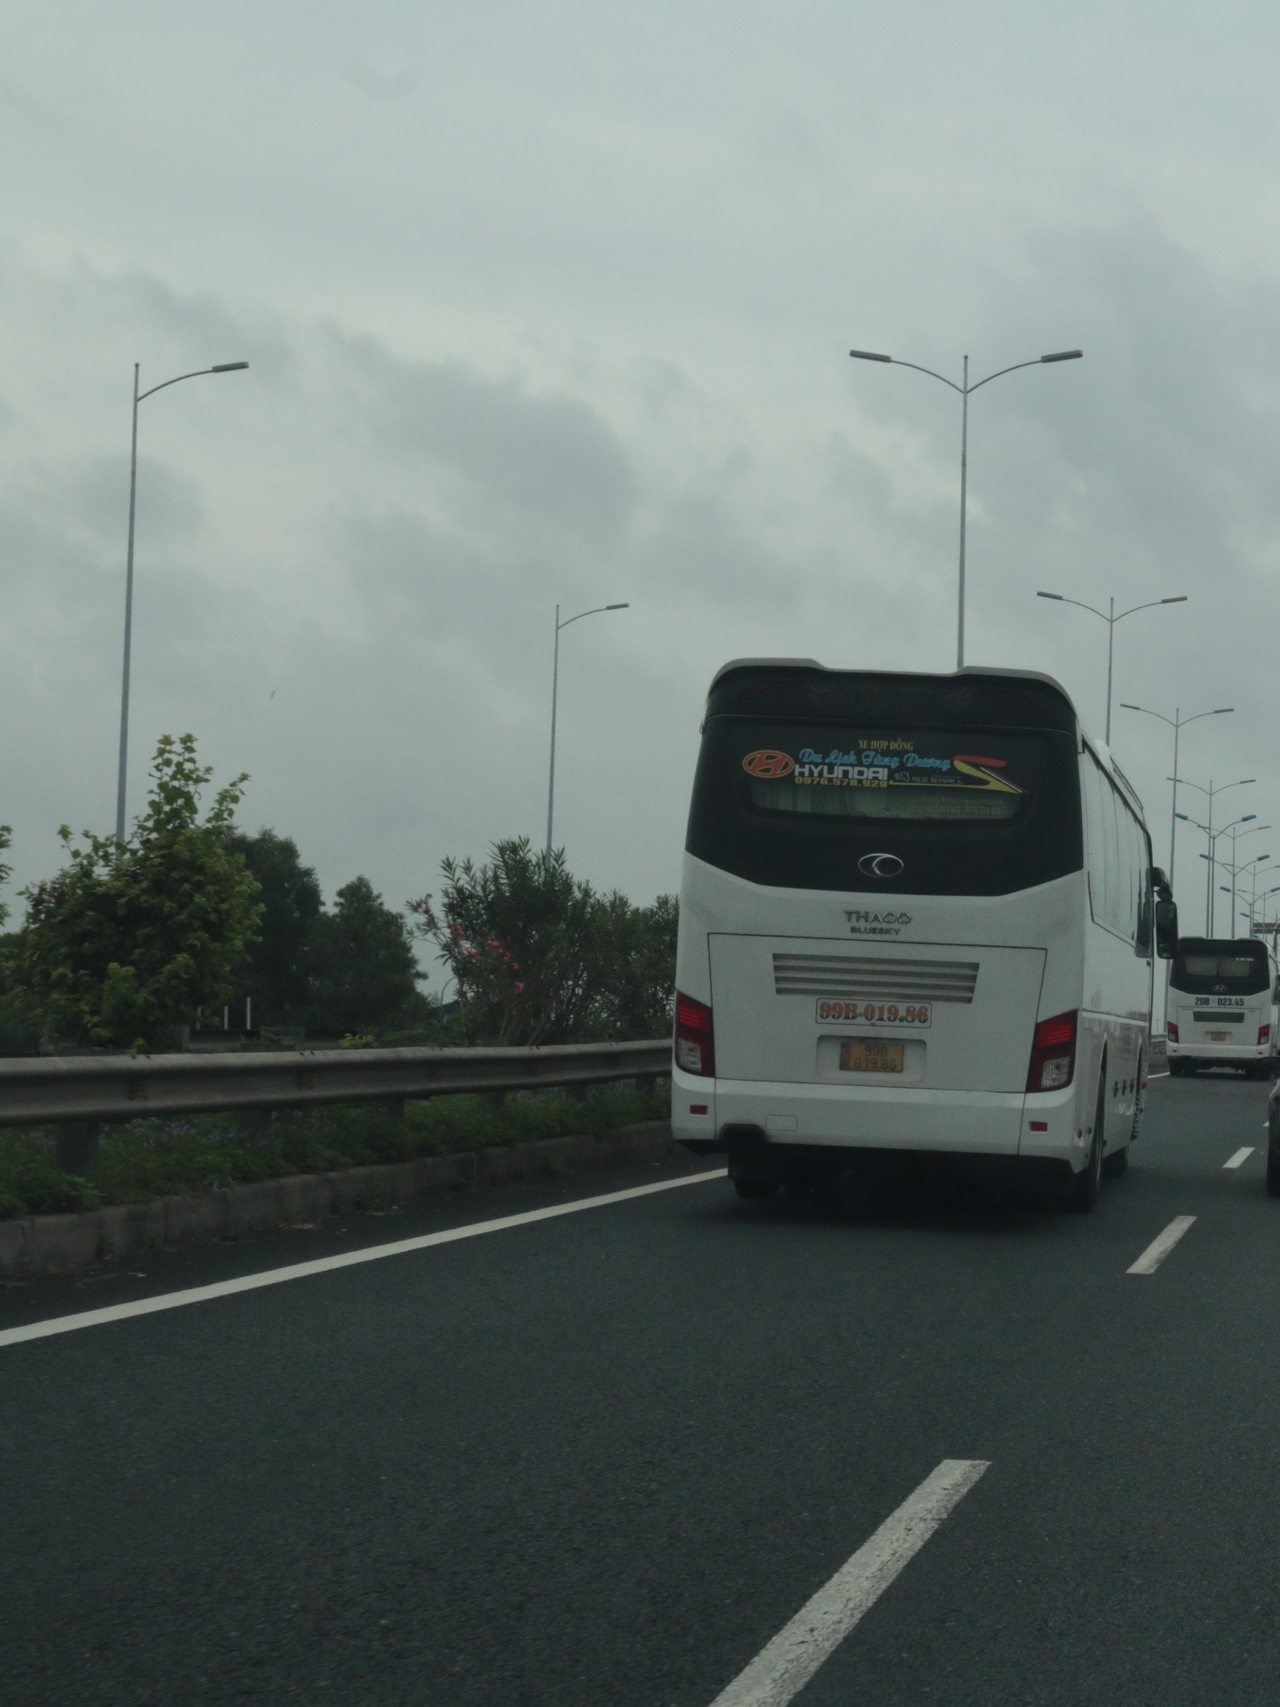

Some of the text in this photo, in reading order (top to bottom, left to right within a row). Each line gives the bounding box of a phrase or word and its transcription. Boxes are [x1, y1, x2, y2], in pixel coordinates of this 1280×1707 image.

[858, 739, 914, 752] XE HỢP ĐỒNG
[799, 748, 823, 762] Du
[794, 764, 888, 780] HYUNDAI
[794, 777, 888, 788] 0976.578.929
[843, 910, 911, 925] THACO
[850, 926, 901, 936] BLUESKY
[1194, 997, 1210, 1006] 20B
[818, 1001, 930, 1025] 99B-019.86
[864, 1045, 888, 1057] 99B
[853, 1057, 898, 1071] 019.86
